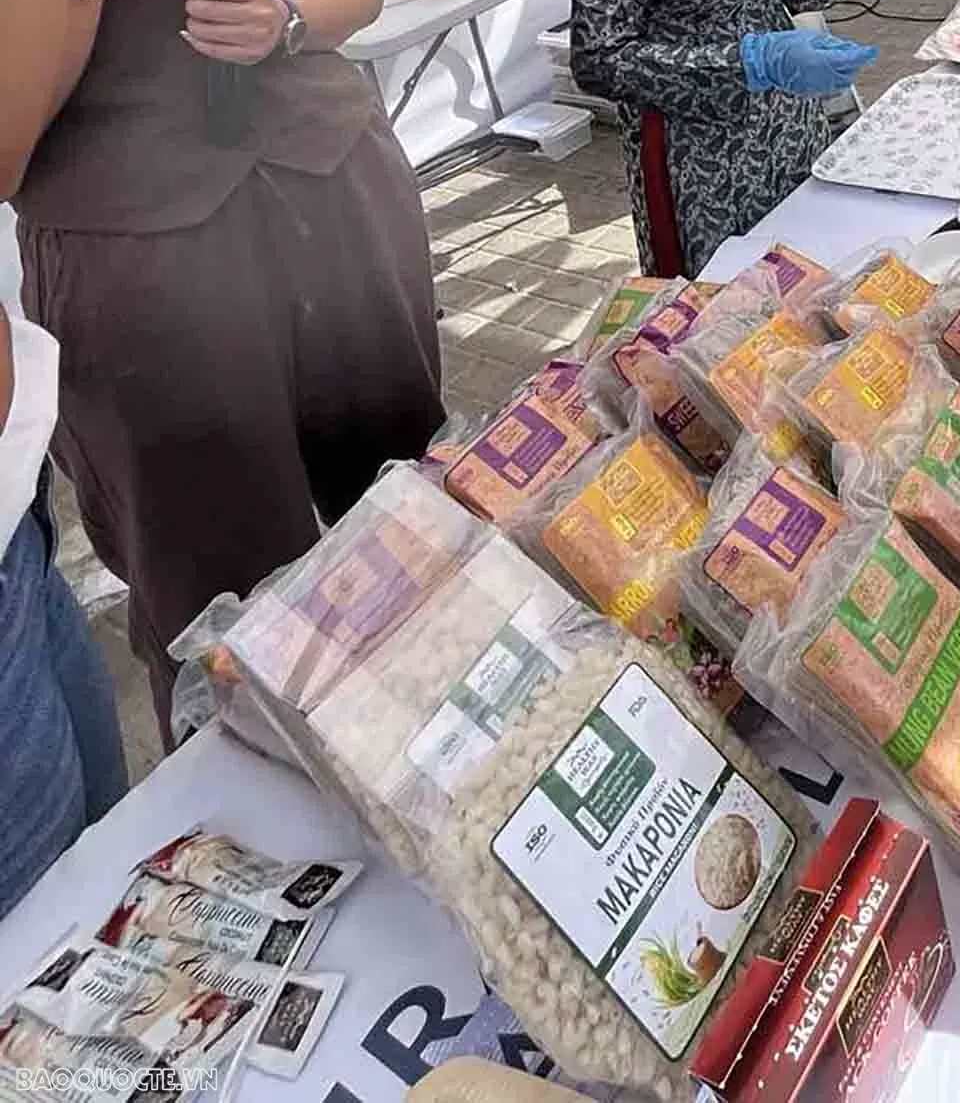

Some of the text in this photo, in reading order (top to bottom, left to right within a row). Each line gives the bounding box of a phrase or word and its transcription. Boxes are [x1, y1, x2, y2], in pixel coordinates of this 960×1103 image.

[525, 824, 548, 853] ISO
[786, 956, 848, 1062] ΣΚΕΤΟΣ
[841, 875, 889, 960] ΚΑΦΕΣ
